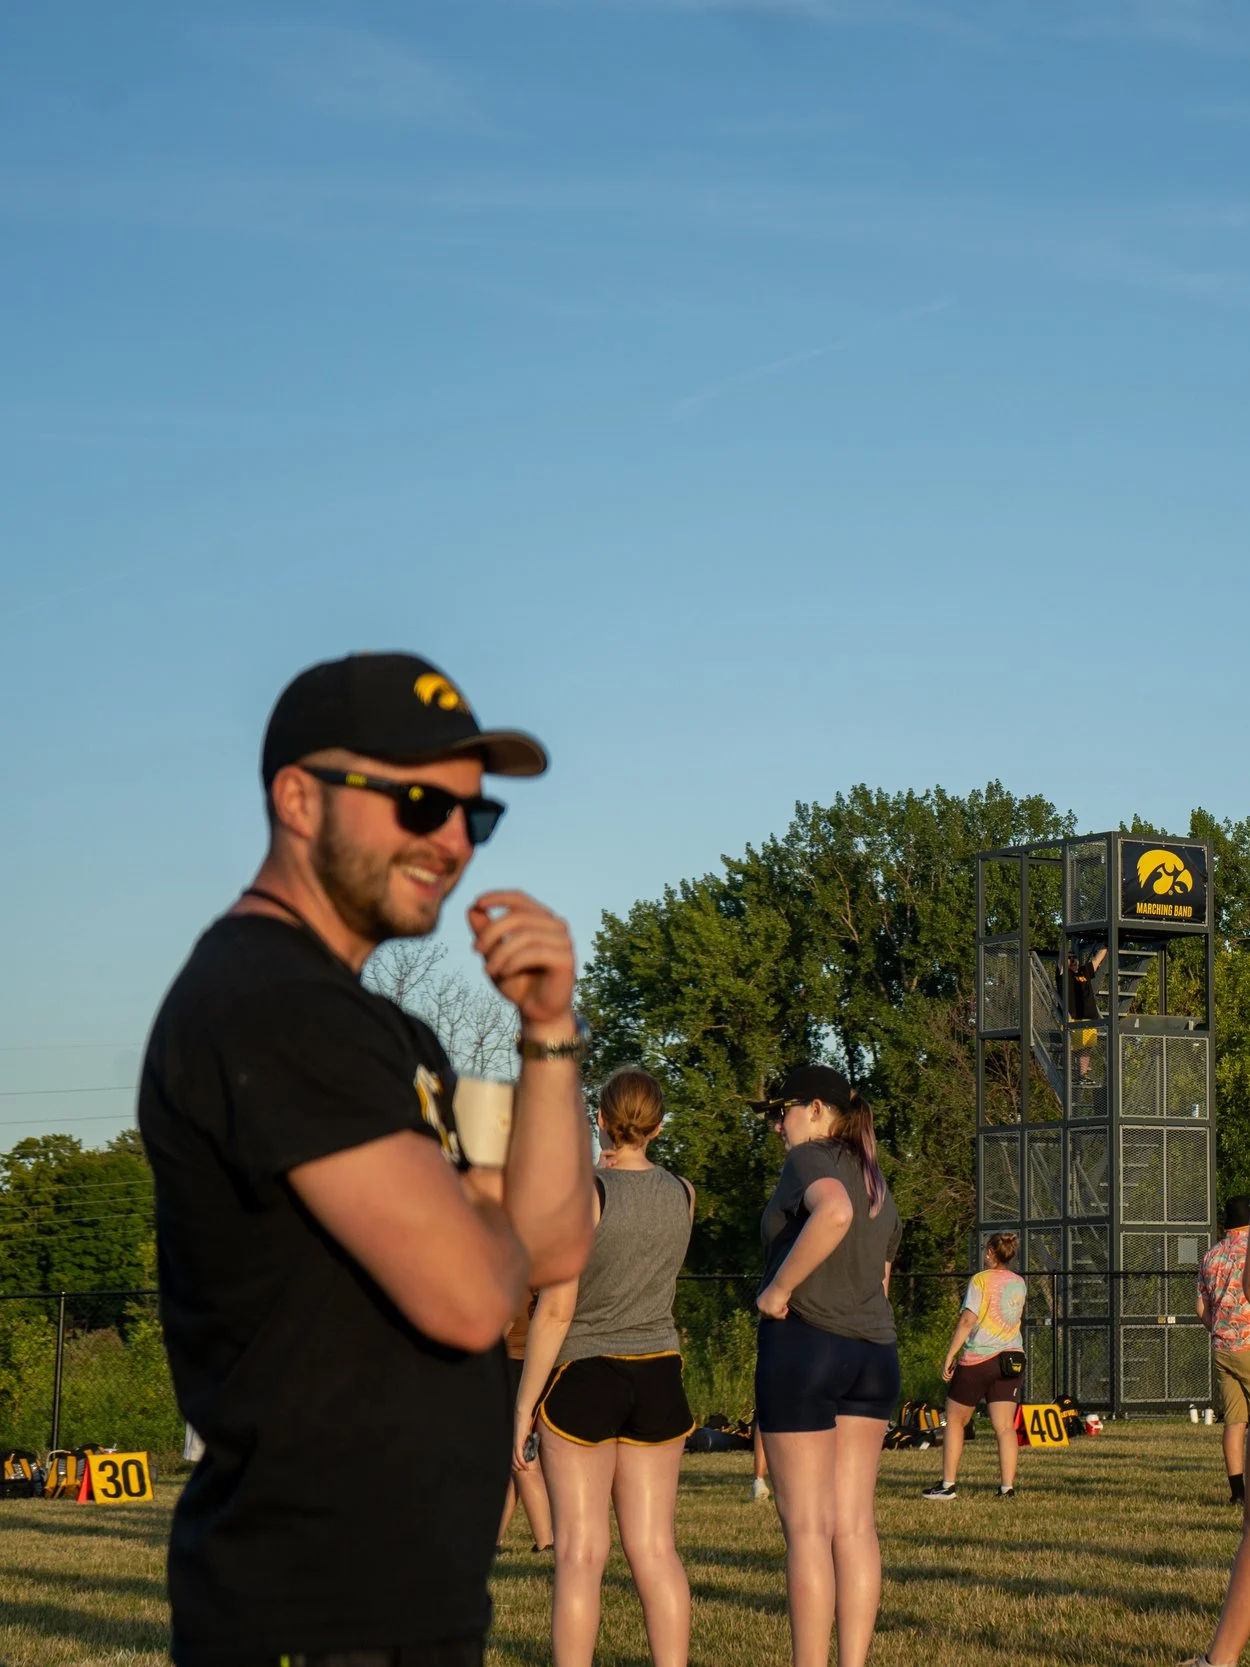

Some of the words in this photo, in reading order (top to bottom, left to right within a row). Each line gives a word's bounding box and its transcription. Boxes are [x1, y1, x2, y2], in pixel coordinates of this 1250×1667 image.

[1136, 902, 1173, 916] MARCHING
[1174, 905, 1193, 918] BAND
[1030, 1408, 1064, 1443] 40
[98, 1459, 147, 1499] 30
